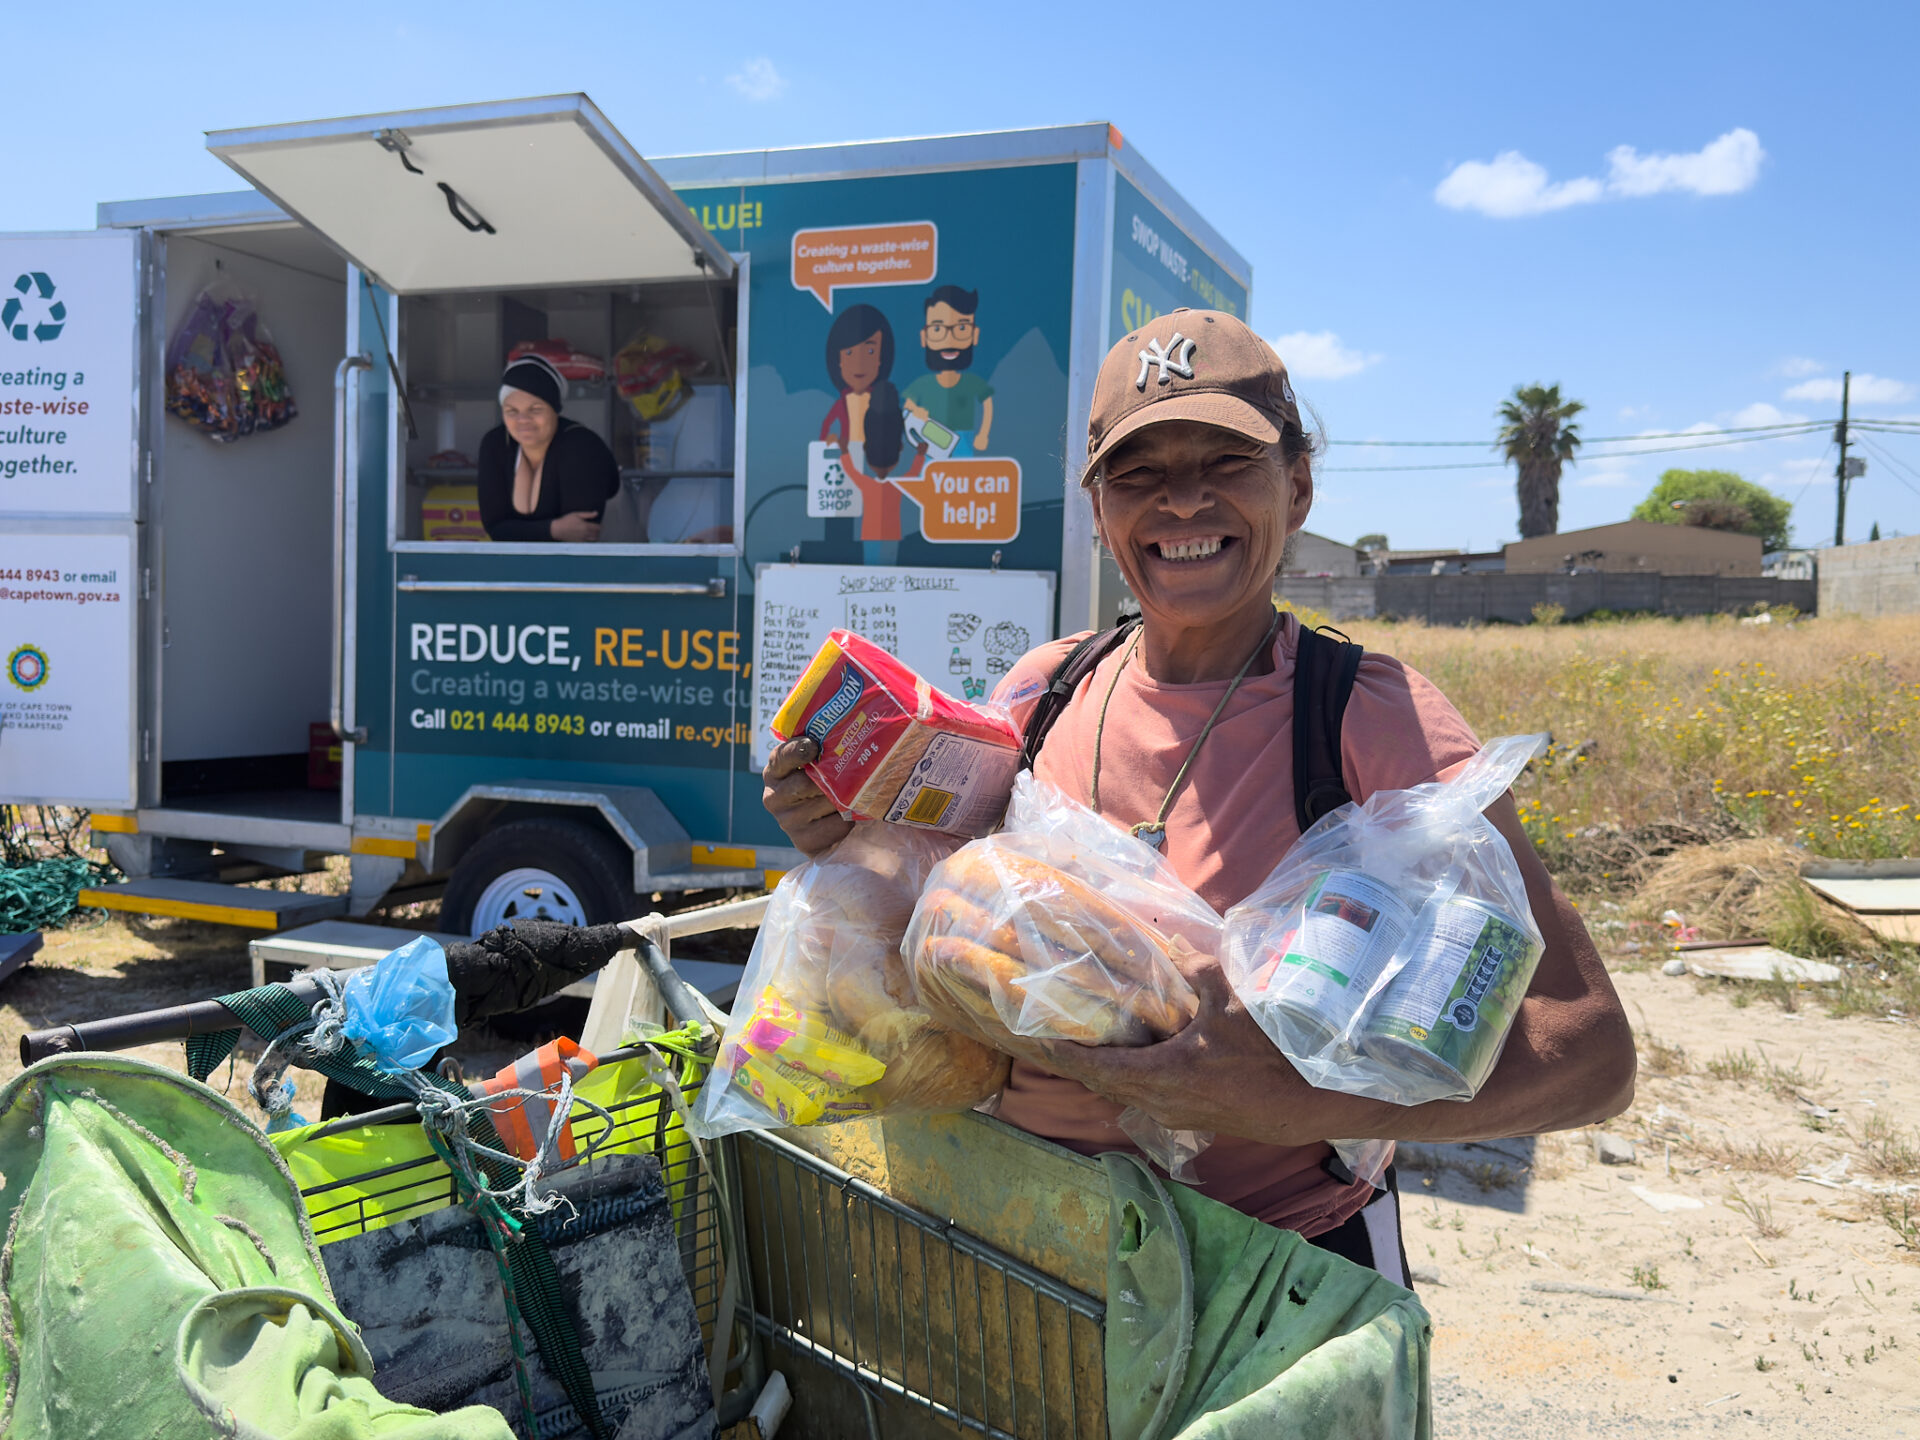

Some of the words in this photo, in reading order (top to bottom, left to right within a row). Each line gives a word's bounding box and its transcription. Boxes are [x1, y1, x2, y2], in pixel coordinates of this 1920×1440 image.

[690, 203, 762, 231] LUE!
[797, 243, 849, 259] Creating
[851, 246, 859, 256] a
[861, 238, 929, 255] waste-wise
[1132, 215, 1159, 257] SWOP
[812, 259, 854, 275] culture
[856, 257, 912, 275] together.
[1136, 332, 1196, 387] NY
[73, 372, 84, 385] a
[818, 488, 853, 500] SWOP
[931, 472, 970, 493] You
[974, 475, 1010, 494] can
[818, 500, 852, 511] SHOP
[943, 502, 997, 530] help!
[26, 569, 60, 582] 8943
[63, 573, 76, 583] or
[81, 571, 116, 583] email
[410, 623, 582, 672] REDUCE,
[594, 627, 752, 679] RE-USE,
[411, 670, 525, 705] Creating
[533, 679, 549, 699] a
[556, 677, 714, 706] waste-wise
[824, 674, 861, 724] RIBBON
[410, 708, 446, 730] Call
[450, 710, 485, 731] 021
[492, 712, 530, 733] 444
[534, 714, 585, 735] 8943
[590, 721, 611, 737] or
[616, 718, 670, 740] email
[841, 720, 861, 748] SLICED
[834, 740, 860, 773] BROWN
[857, 711, 881, 742] BREAD
[857, 748, 872, 766] 700
